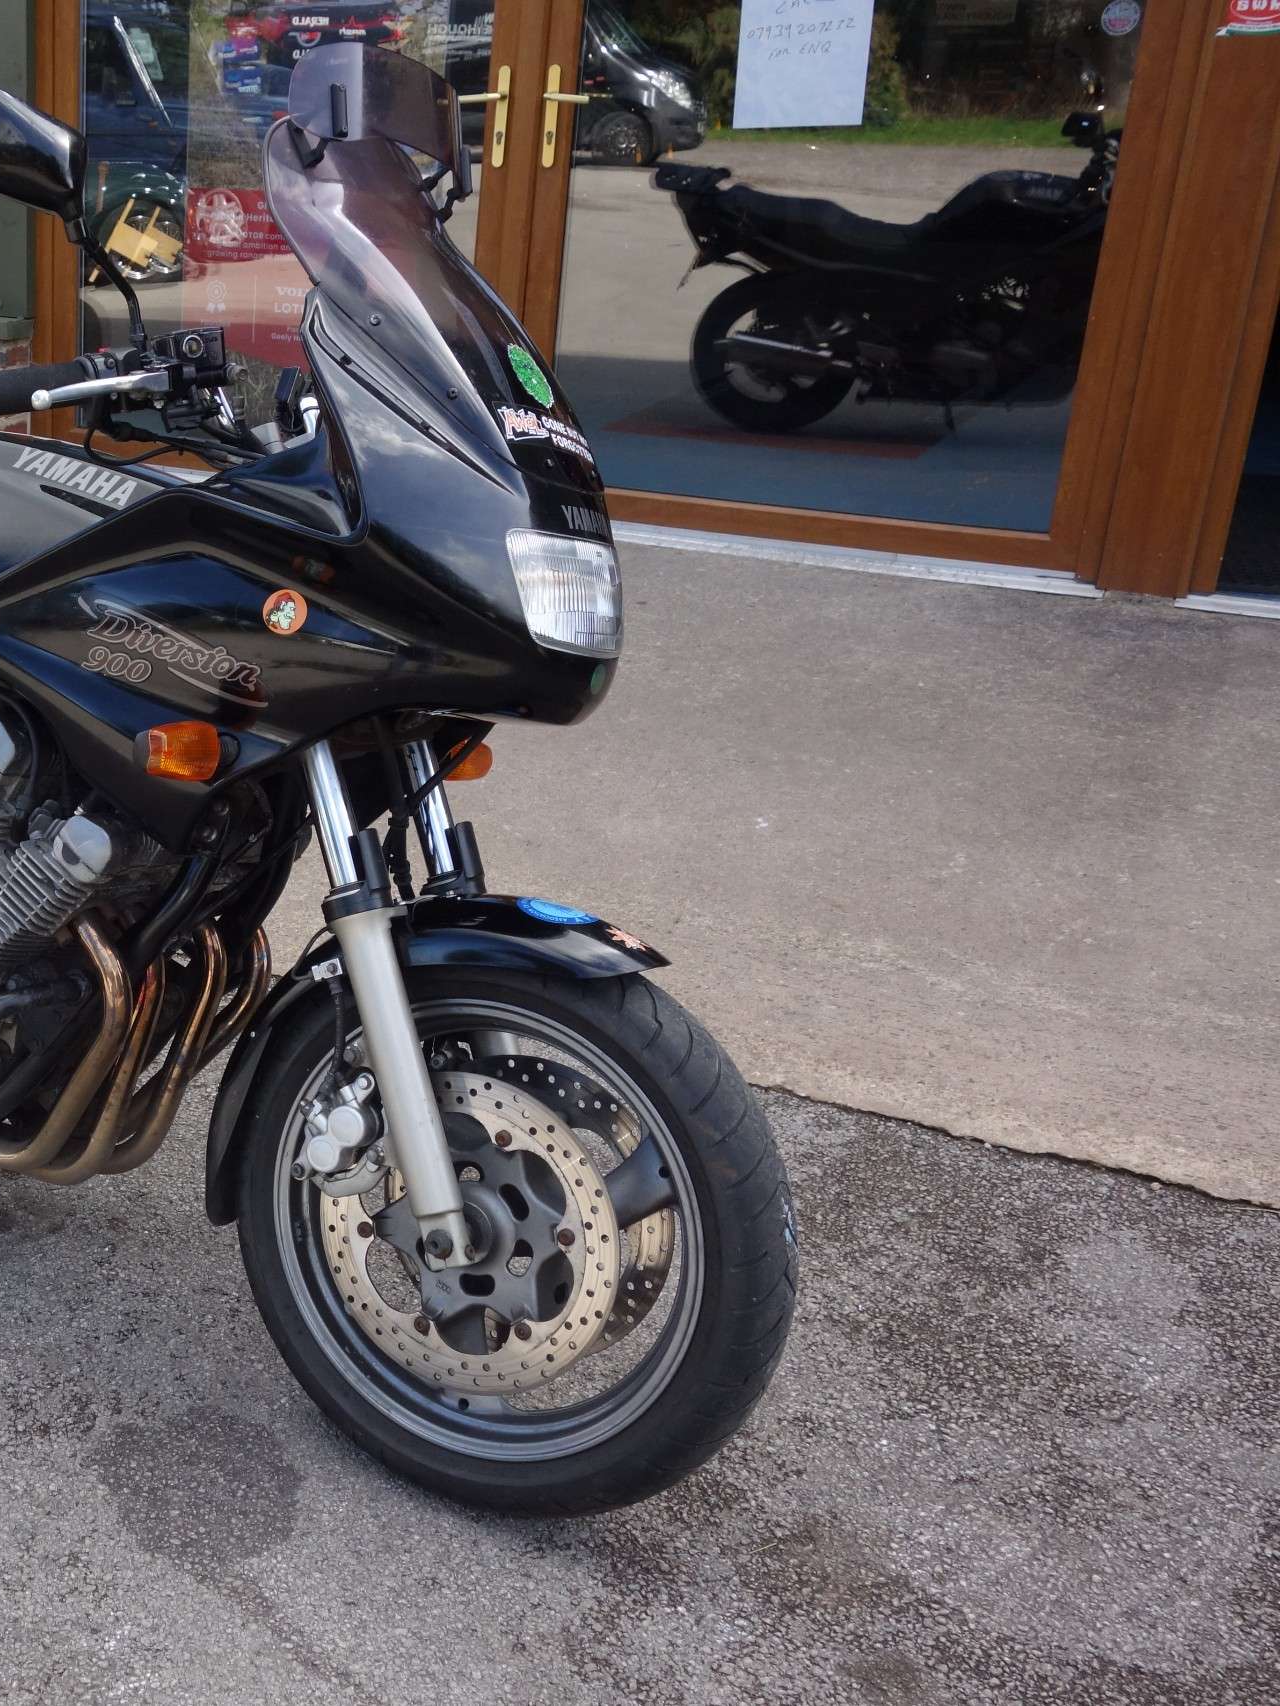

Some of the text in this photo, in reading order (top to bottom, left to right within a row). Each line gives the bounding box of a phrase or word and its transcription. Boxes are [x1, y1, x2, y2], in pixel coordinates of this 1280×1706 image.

[12, 446, 138, 507] YAMAHA
[81, 646, 152, 683] 900
[87, 609, 261, 692] Diversion
